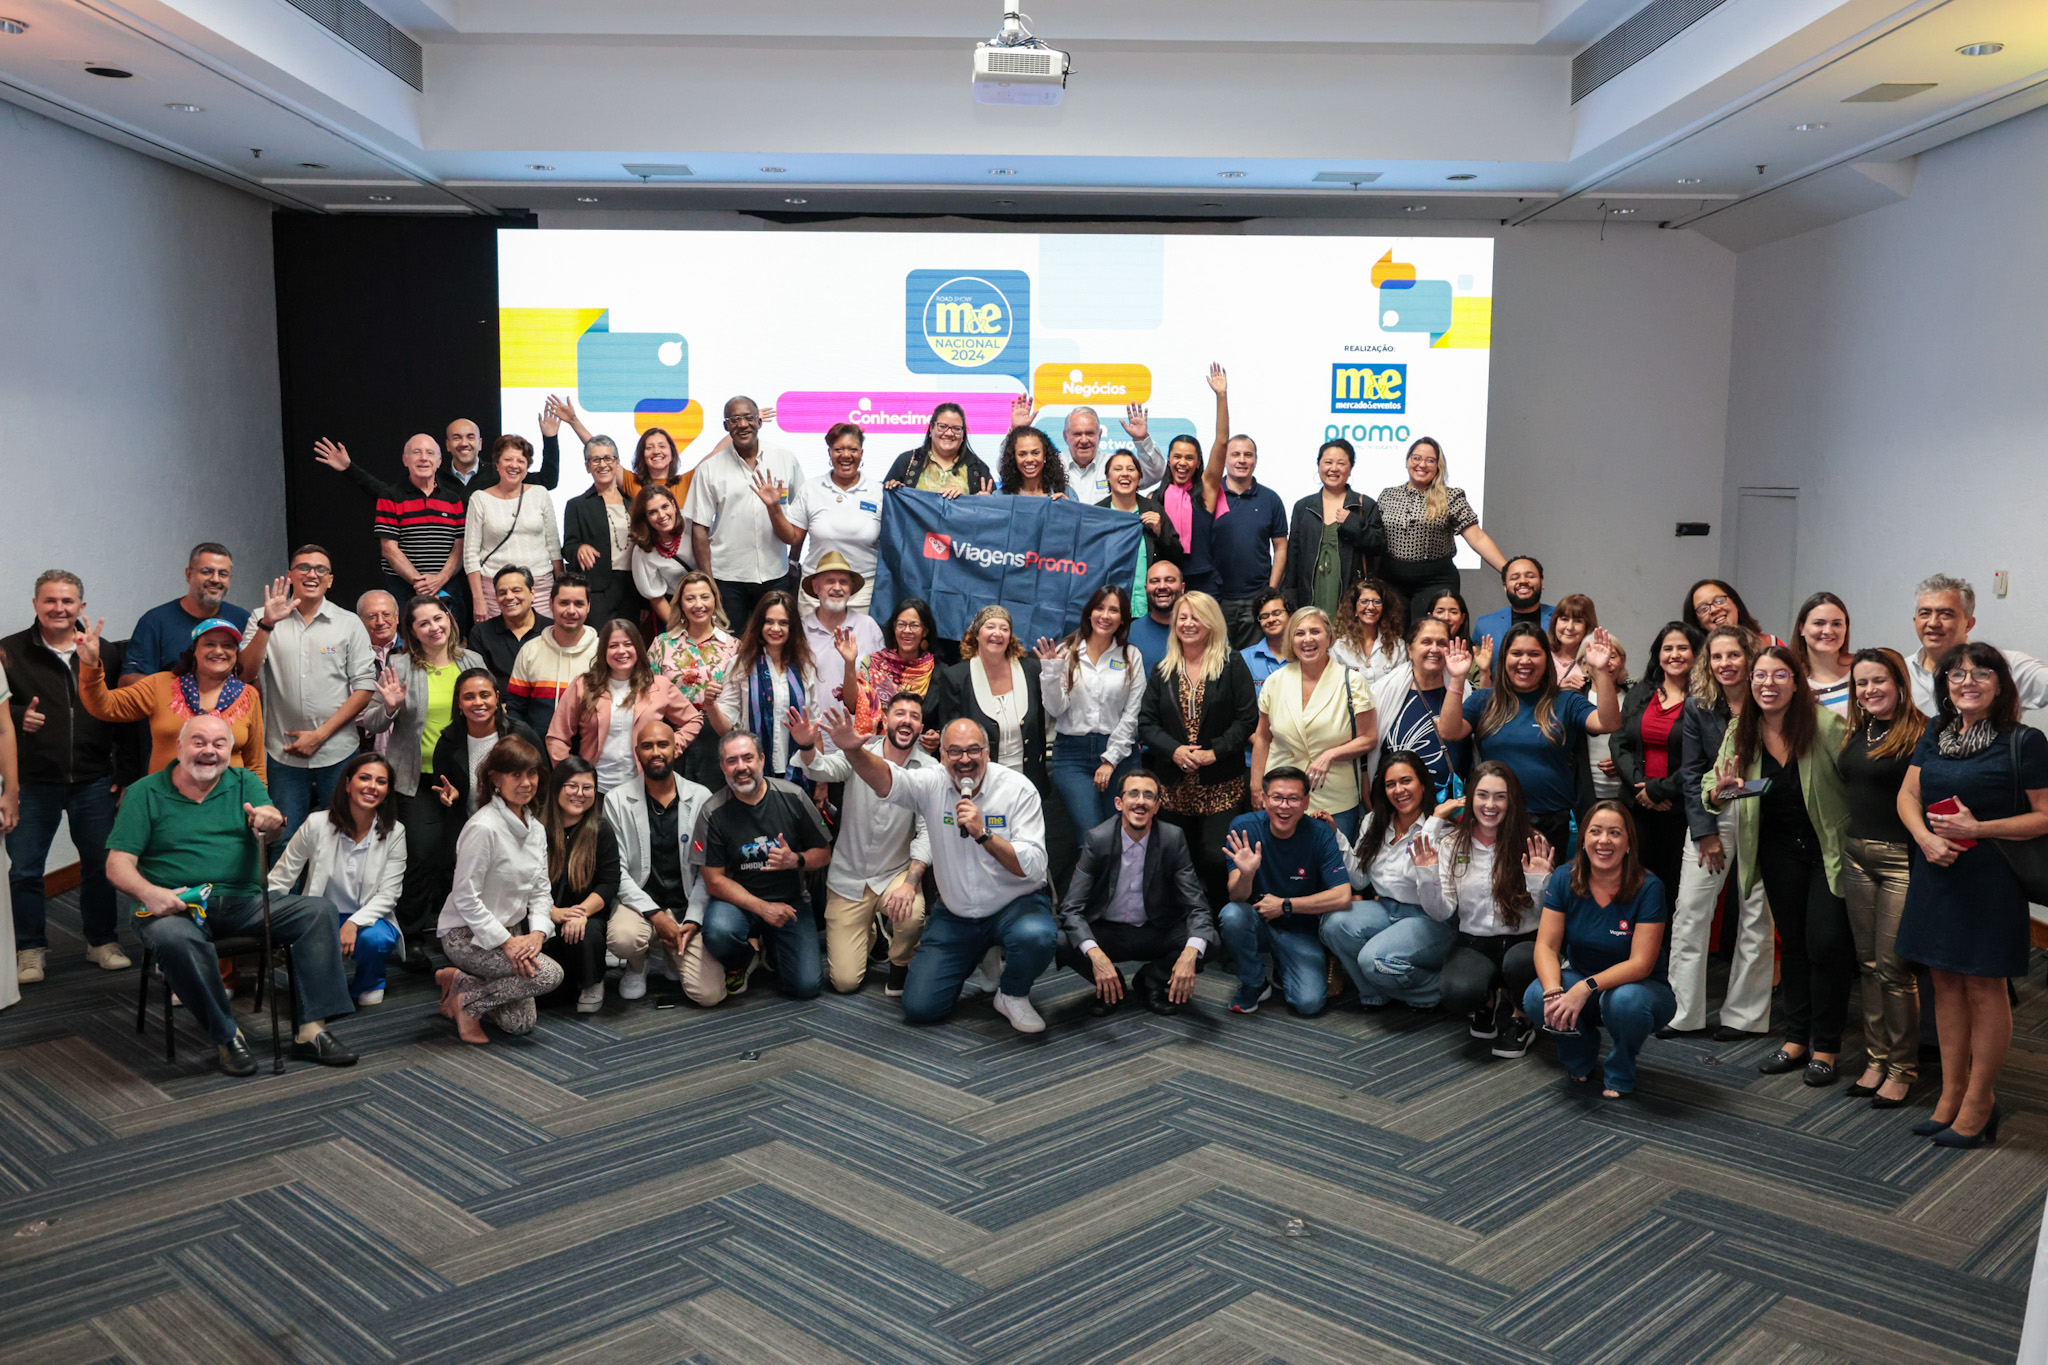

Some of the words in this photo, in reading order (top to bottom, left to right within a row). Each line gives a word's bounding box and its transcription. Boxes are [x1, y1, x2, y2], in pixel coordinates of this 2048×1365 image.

[936, 302, 1002, 333] m&e
[935, 339, 1000, 349] NACIONAL
[1344, 344, 1396, 353] REALIZAÇÃO:
[951, 349, 985, 361] 2024
[1063, 381, 1127, 398] Negócios
[1336, 368, 1402, 400] m&e
[1335, 401, 1402, 410] mercado&eventos
[1325, 424, 1410, 443] promo
[952, 541, 1087, 576] ViagensPromo
